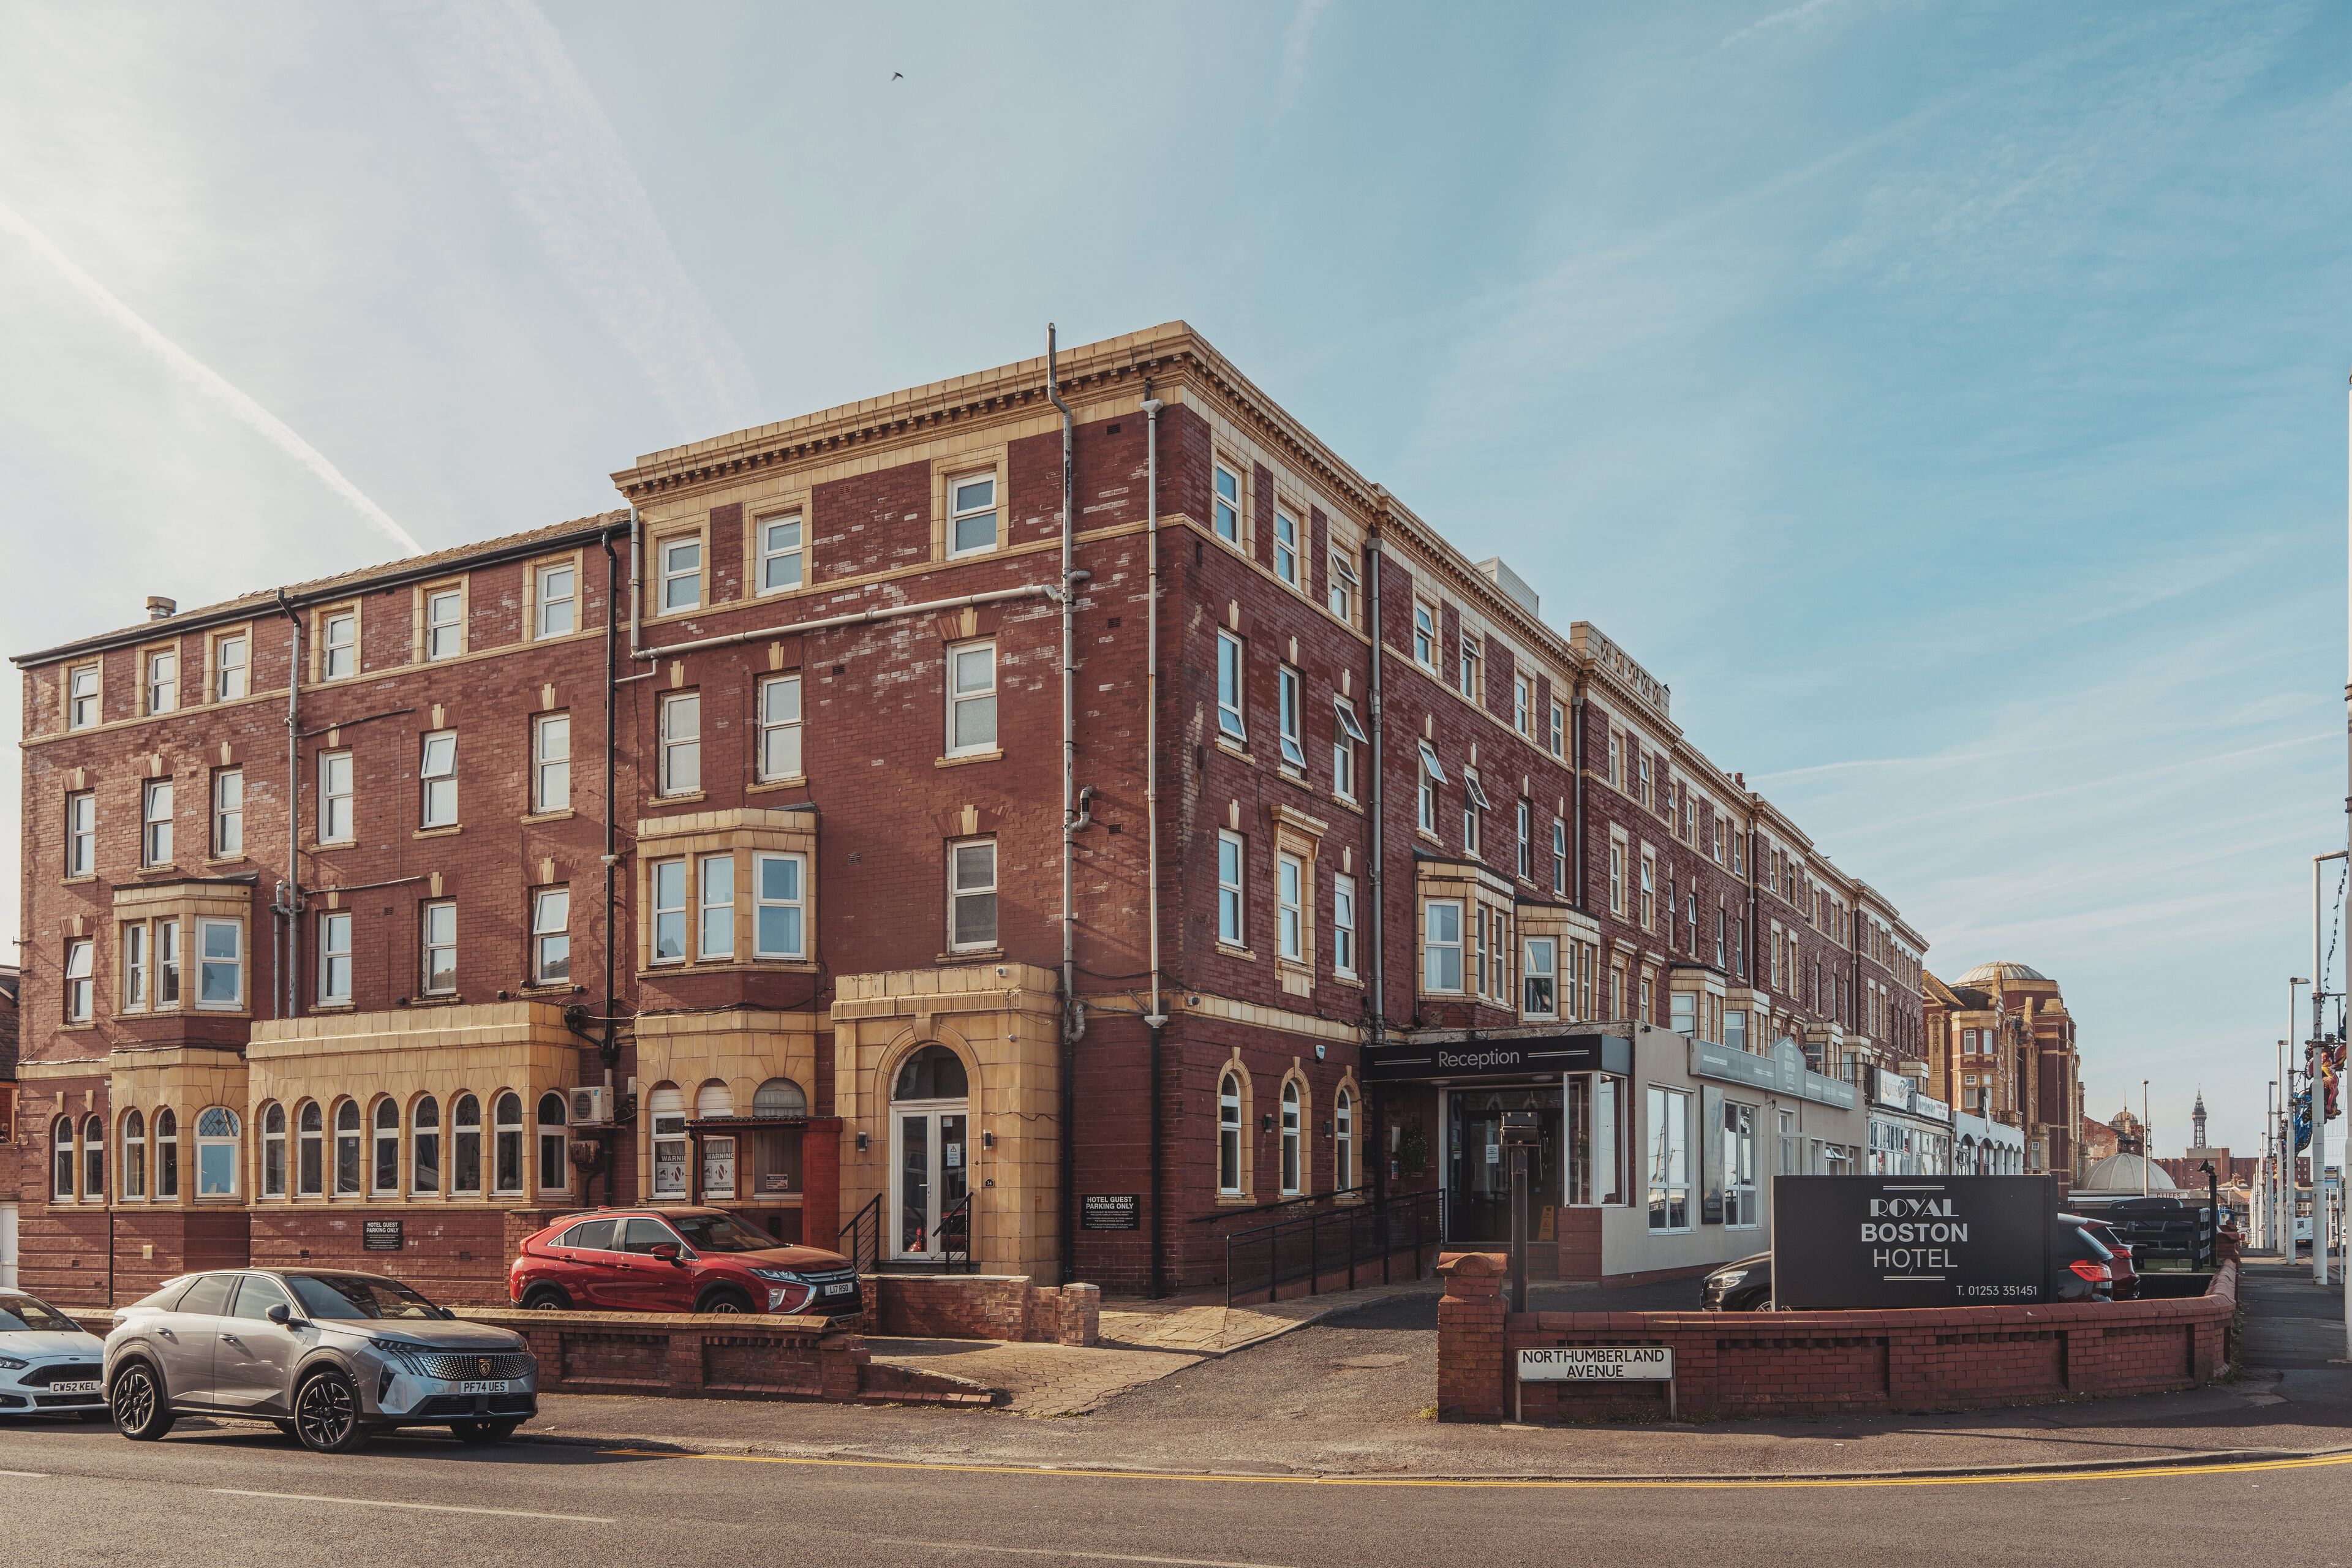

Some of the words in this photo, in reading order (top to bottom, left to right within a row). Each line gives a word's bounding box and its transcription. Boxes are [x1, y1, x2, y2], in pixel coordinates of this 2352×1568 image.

[1439, 1048, 1520, 1069] Reception
[1870, 1198, 1959, 1217] ROYAL
[1861, 1223, 1968, 1242] BOSTON
[1874, 1248, 1958, 1268] HOTEL
[839, 1284, 849, 1292] RSO
[1956, 1285, 1965, 1296] T.
[1968, 1285, 1999, 1296] 01253
[2003, 1285, 2038, 1296] 351451
[1523, 1349, 1664, 1363] NORTHUMBERLAND
[1567, 1365, 1624, 1378] AVENUE
[53, 1382, 77, 1392] CW52
[79, 1382, 96, 1391] KEL
[464, 1382, 487, 1392] PF74
[489, 1381, 505, 1392] UES
